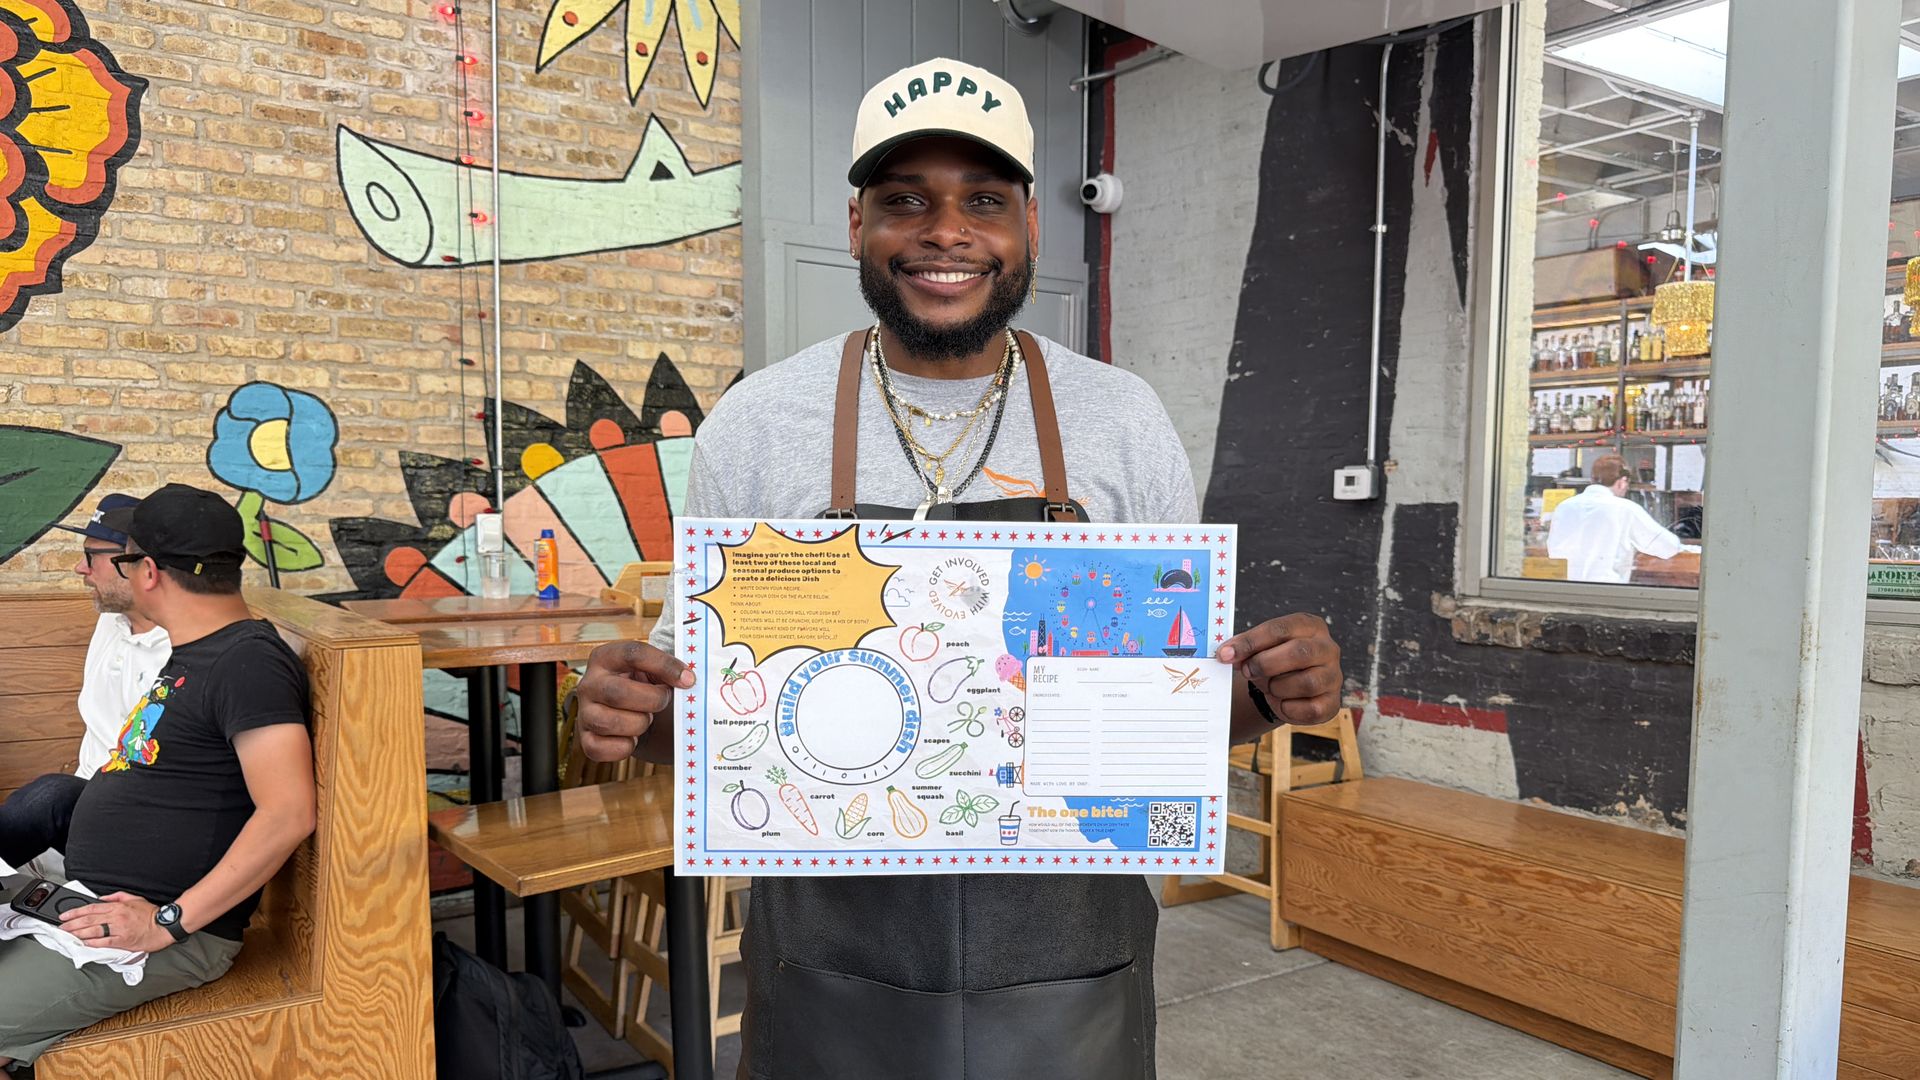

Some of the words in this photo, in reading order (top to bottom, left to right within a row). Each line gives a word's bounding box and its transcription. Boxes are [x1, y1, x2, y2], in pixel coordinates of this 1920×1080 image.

[884, 72, 1002, 118] HAPPY
[929, 566, 943, 585] GET
[945, 558, 989, 586] INVOLVED
[929, 590, 966, 620] EVOLVED
[970, 592, 990, 615] WITH
[1033, 674, 1058, 683] RECIPE
[1034, 665, 1046, 674] MY
[779, 679, 802, 736] Build
[798, 651, 844, 684] your
[848, 650, 915, 706] summer
[896, 710, 921, 754] dish
[1027, 806, 1057, 818] The
[1060, 808, 1088, 818] one
[1091, 806, 1128, 818] bite!
